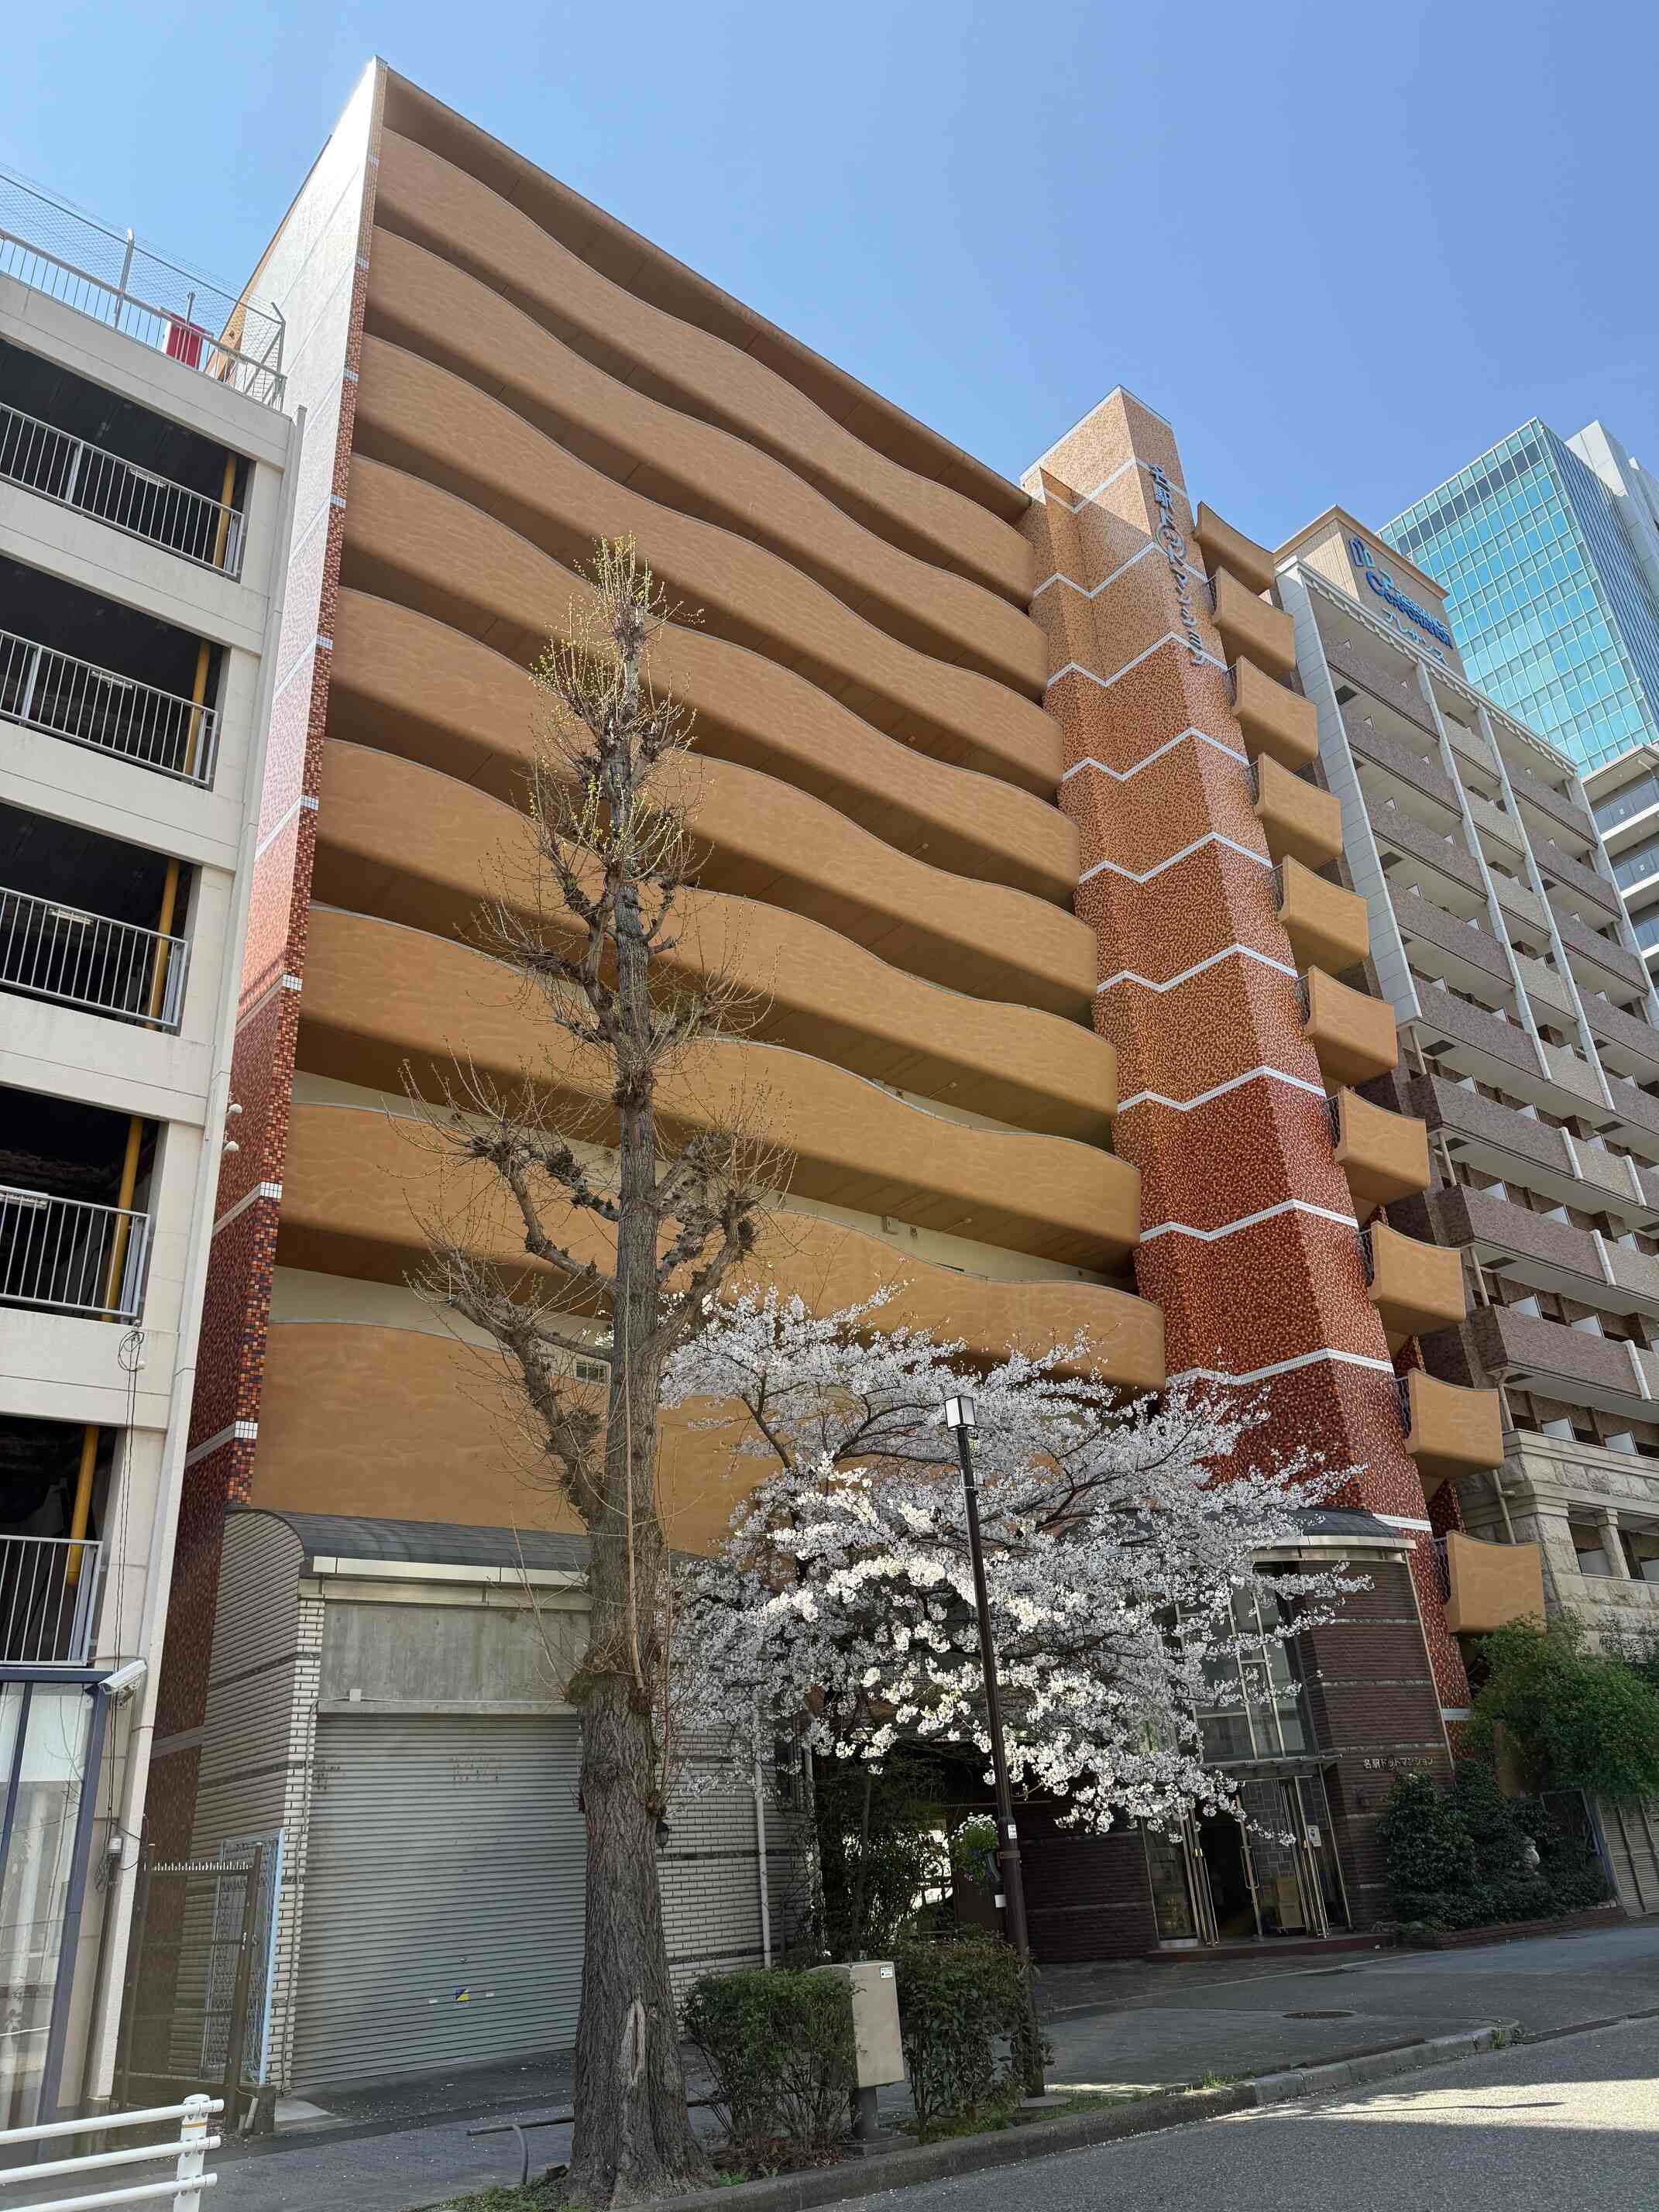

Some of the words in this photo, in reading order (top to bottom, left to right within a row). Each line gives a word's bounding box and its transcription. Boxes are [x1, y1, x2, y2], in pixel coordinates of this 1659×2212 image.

[1363, 1757, 1434, 1769] 名駅ドットマンション
